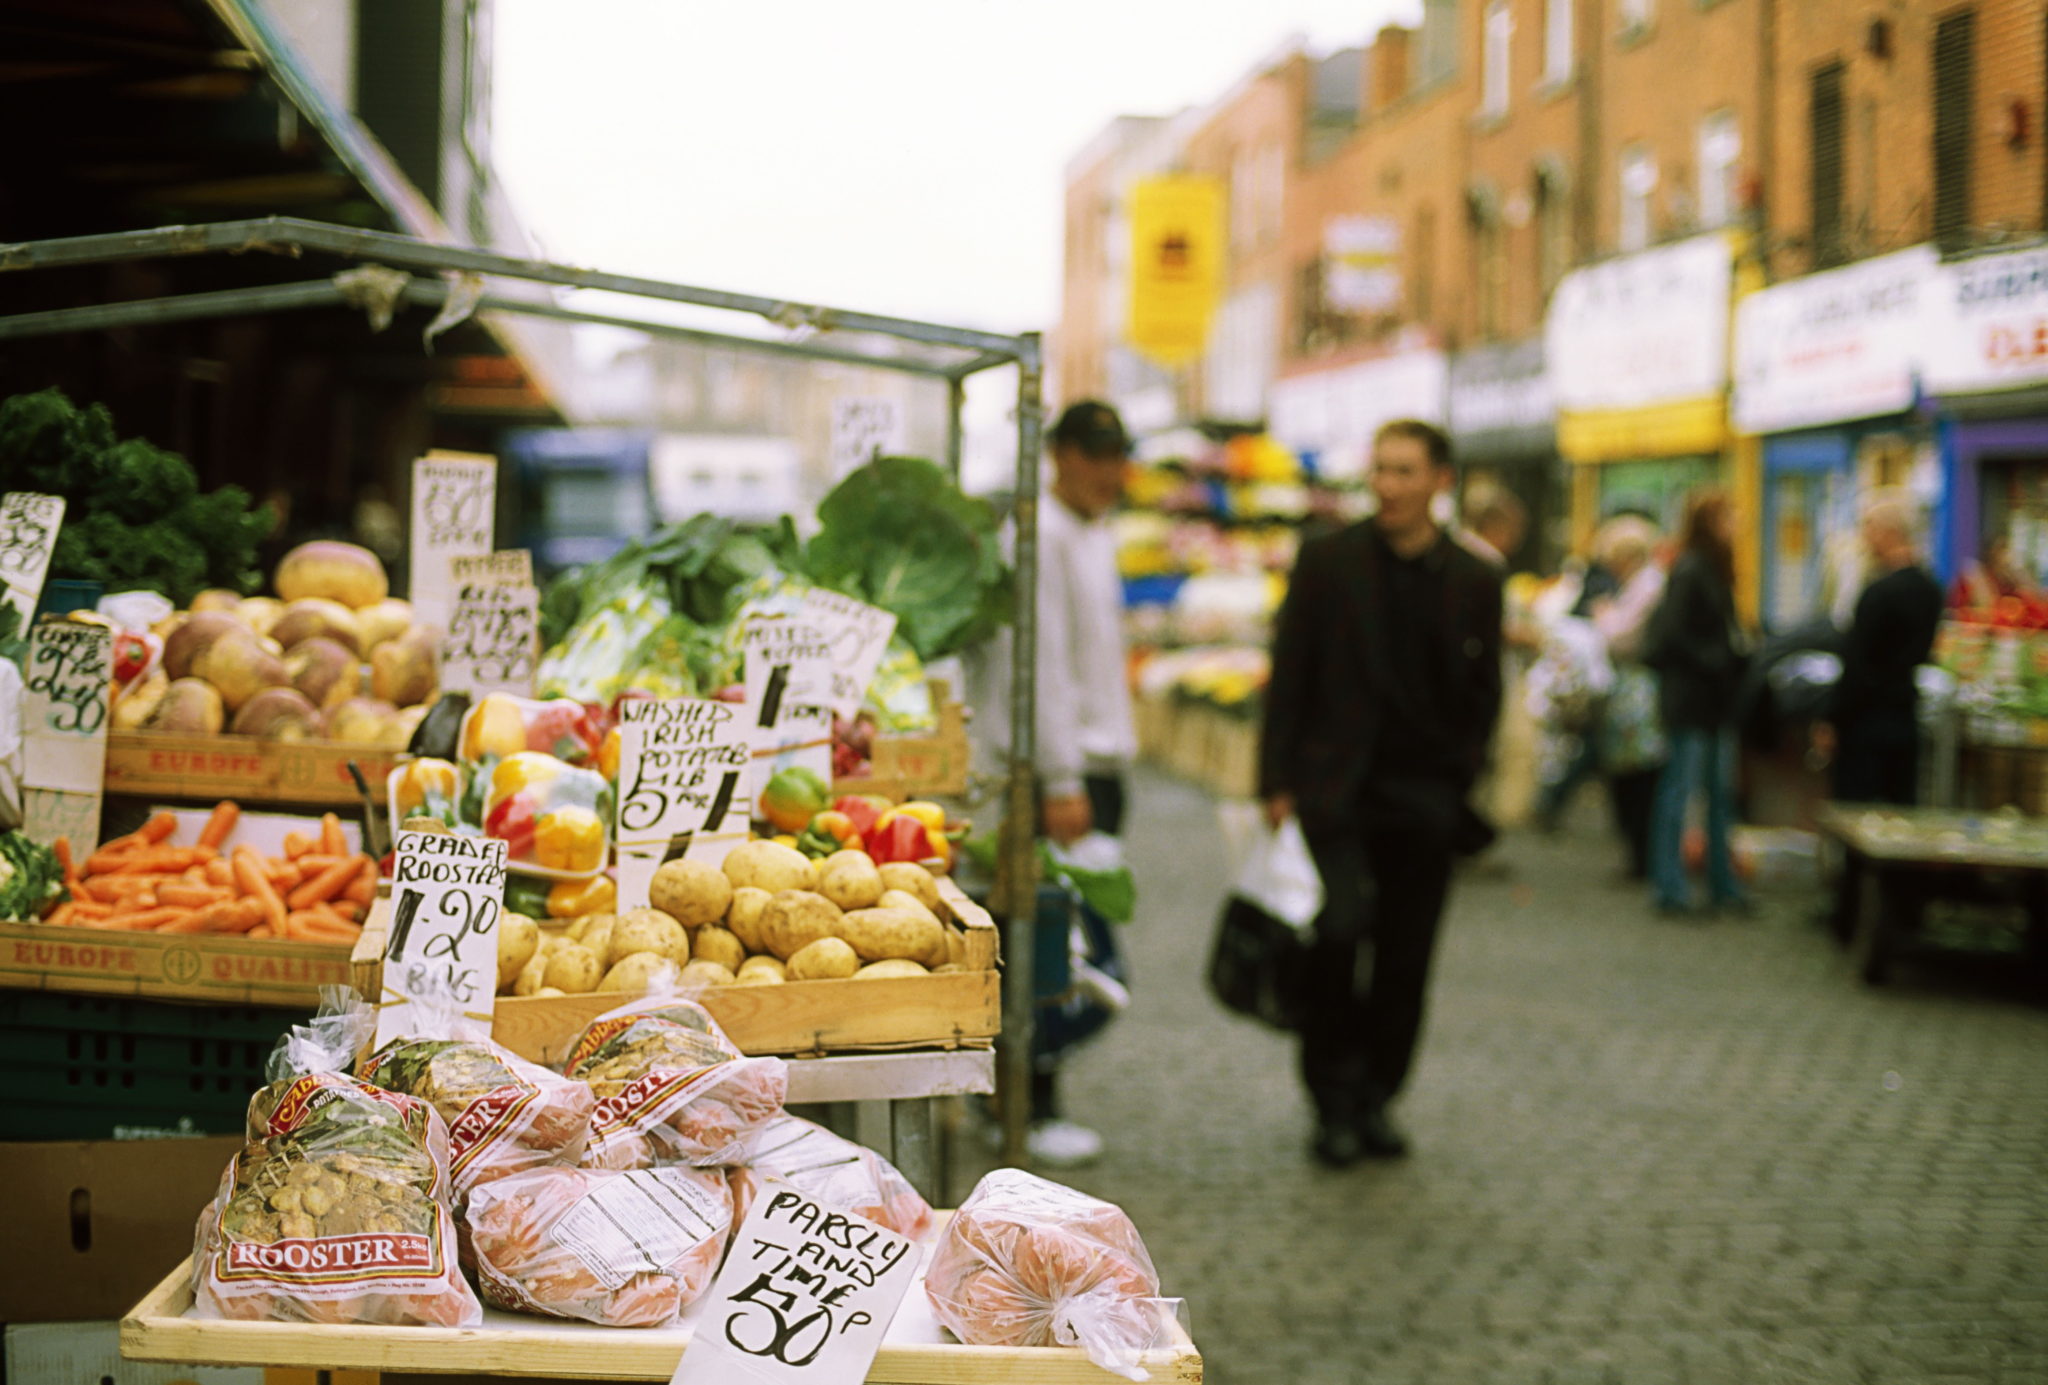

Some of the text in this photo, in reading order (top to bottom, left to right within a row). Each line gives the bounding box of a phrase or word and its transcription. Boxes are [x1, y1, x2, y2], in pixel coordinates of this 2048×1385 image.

[642, 722, 718, 749] IRISH
[14, 941, 137, 972] EUROPE
[234, 1237, 399, 1269] ROOSTER
[764, 1191, 911, 1277] PARSLY
[752, 1238, 859, 1309] TIME
[796, 1241, 876, 1288] AND
